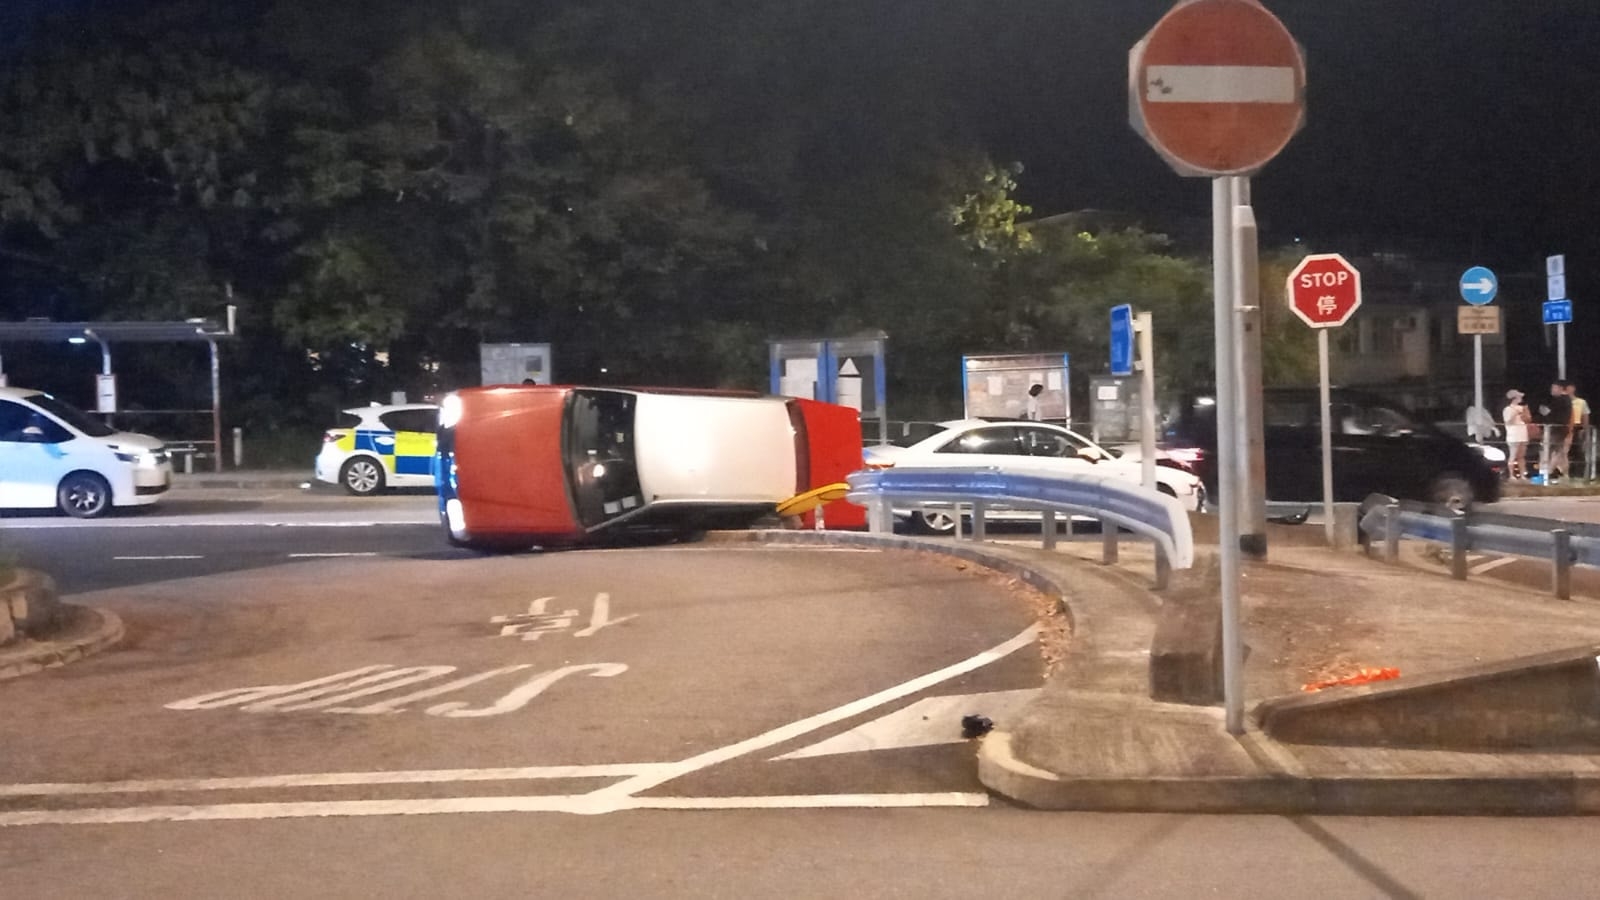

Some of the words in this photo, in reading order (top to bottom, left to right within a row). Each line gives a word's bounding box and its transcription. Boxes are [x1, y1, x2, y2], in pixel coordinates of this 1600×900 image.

[1301, 272, 1348, 288] STOP
[1317, 296, 1337, 315] 停
[163, 663, 629, 718] STOP
